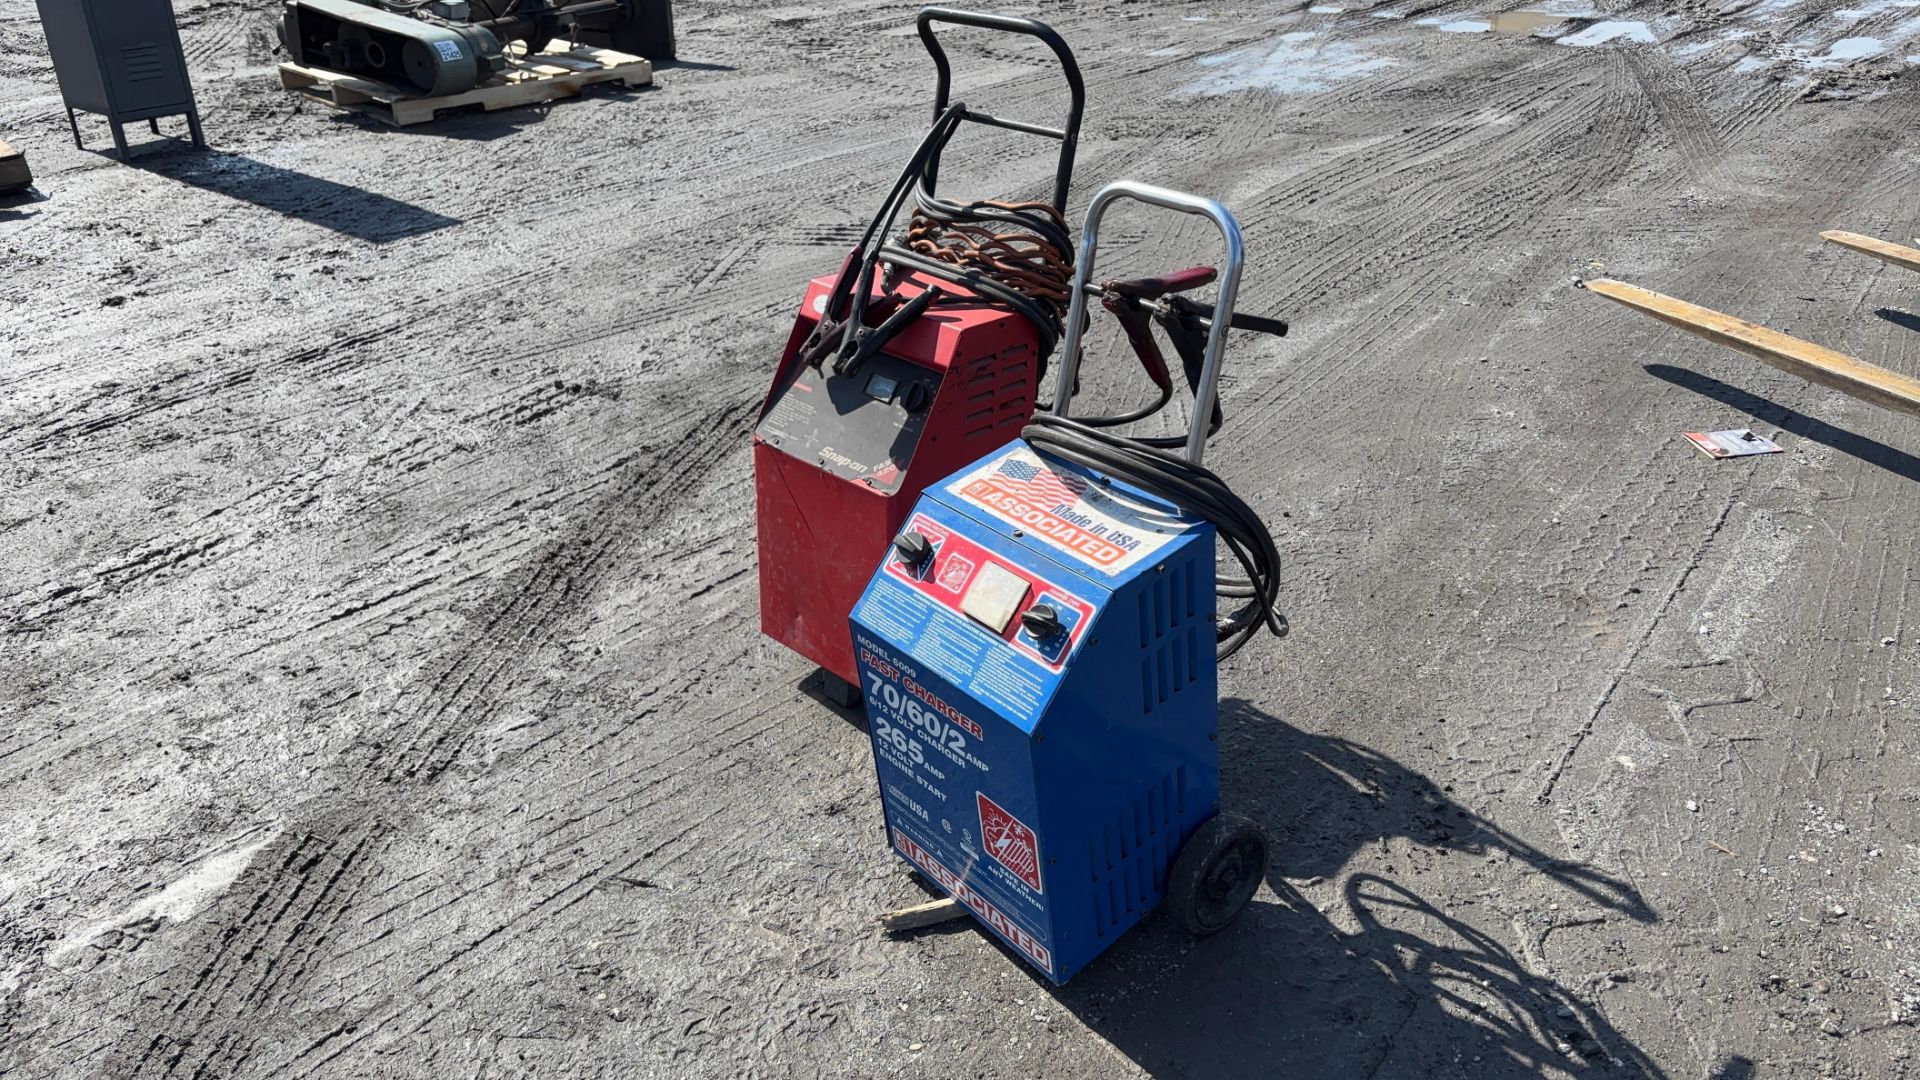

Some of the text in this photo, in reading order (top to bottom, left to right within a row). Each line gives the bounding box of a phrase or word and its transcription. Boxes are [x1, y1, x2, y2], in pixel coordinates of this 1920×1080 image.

[818, 446, 868, 474] Snap-on
[982, 491, 1119, 561] ASSOCIATED
[1050, 504, 1142, 551] Made in USA
[857, 634, 917, 678] MODEL 6009
[860, 647, 900, 684] FAST
[902, 676, 983, 741] CHARGER
[867, 671, 966, 757] 70/60/2
[966, 752, 989, 772] AMP
[891, 709, 915, 732] VOLT
[917, 729, 966, 768] CHARGER
[876, 716, 945, 780] 265 AMP
[878, 738, 915, 768] 12 VOLT
[879, 748, 914, 778] ENGINE
[916, 775, 948, 802] START
[909, 798, 929, 822] USA
[988, 865, 1003, 879] ANY
[1005, 878, 1044, 912] WEATHER!
[999, 866, 1030, 894] SAFE IN
[914, 848, 1049, 969] ASSOCIATED
